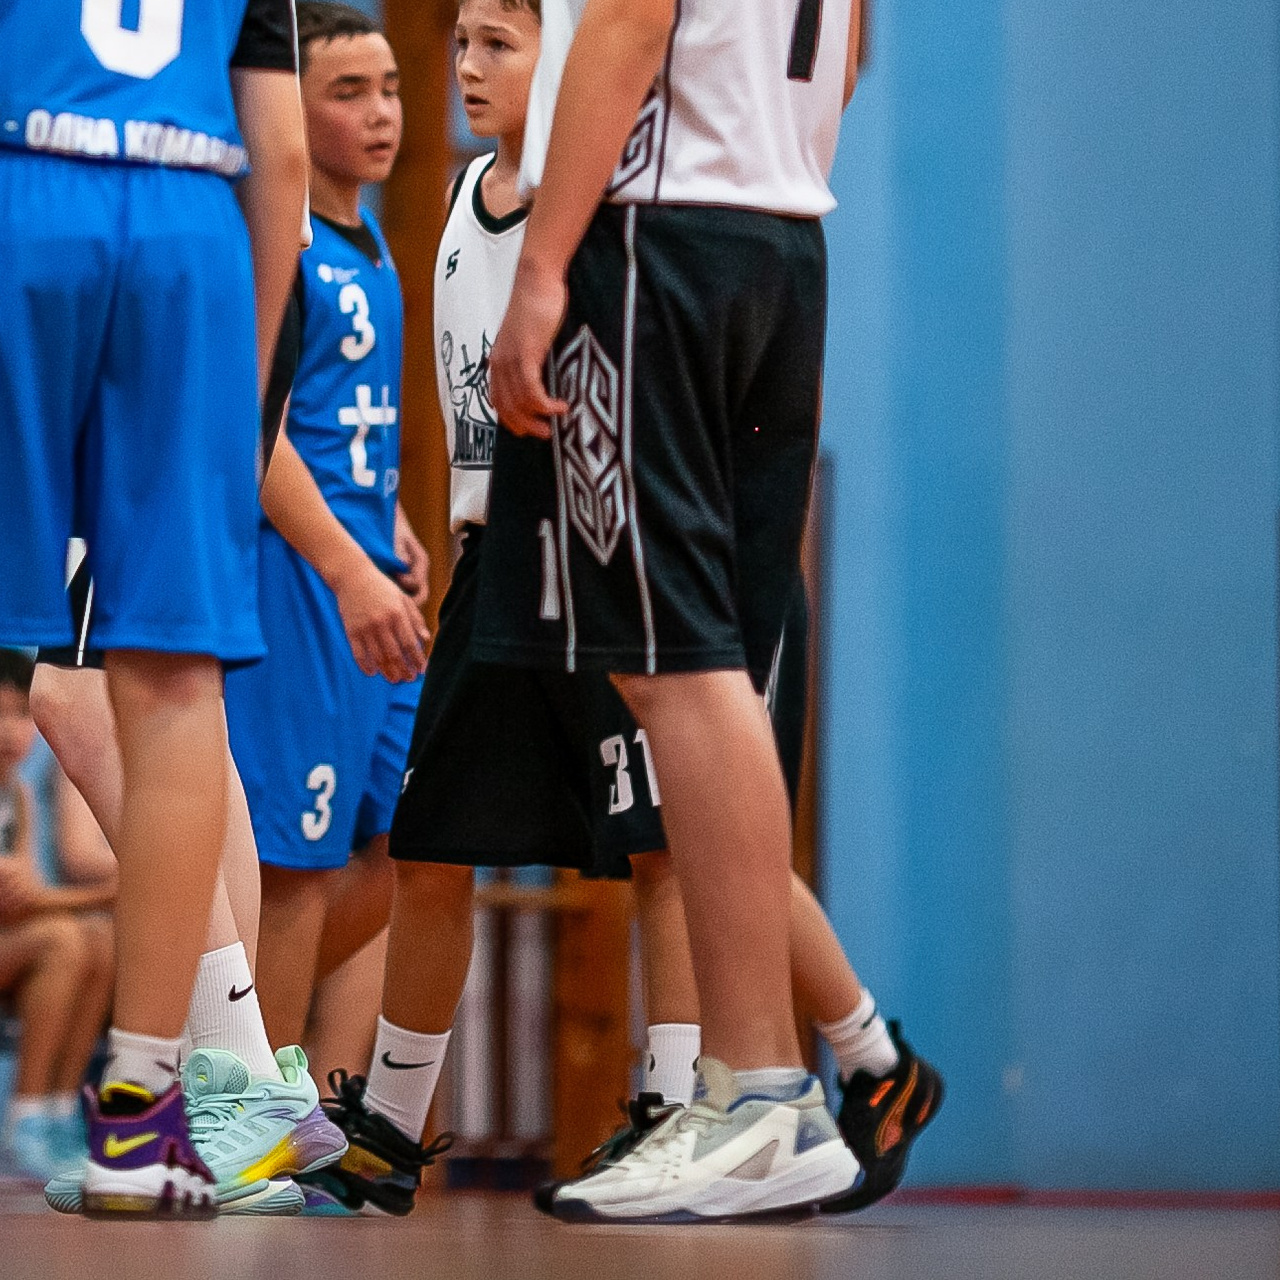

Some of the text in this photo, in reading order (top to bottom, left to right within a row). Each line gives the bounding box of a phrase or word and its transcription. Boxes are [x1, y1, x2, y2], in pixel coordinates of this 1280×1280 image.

[338, 282, 376, 361] 3
[537, 517, 562, 621] 1
[301, 765, 336, 841] 3
[600, 728, 661, 815] 31
